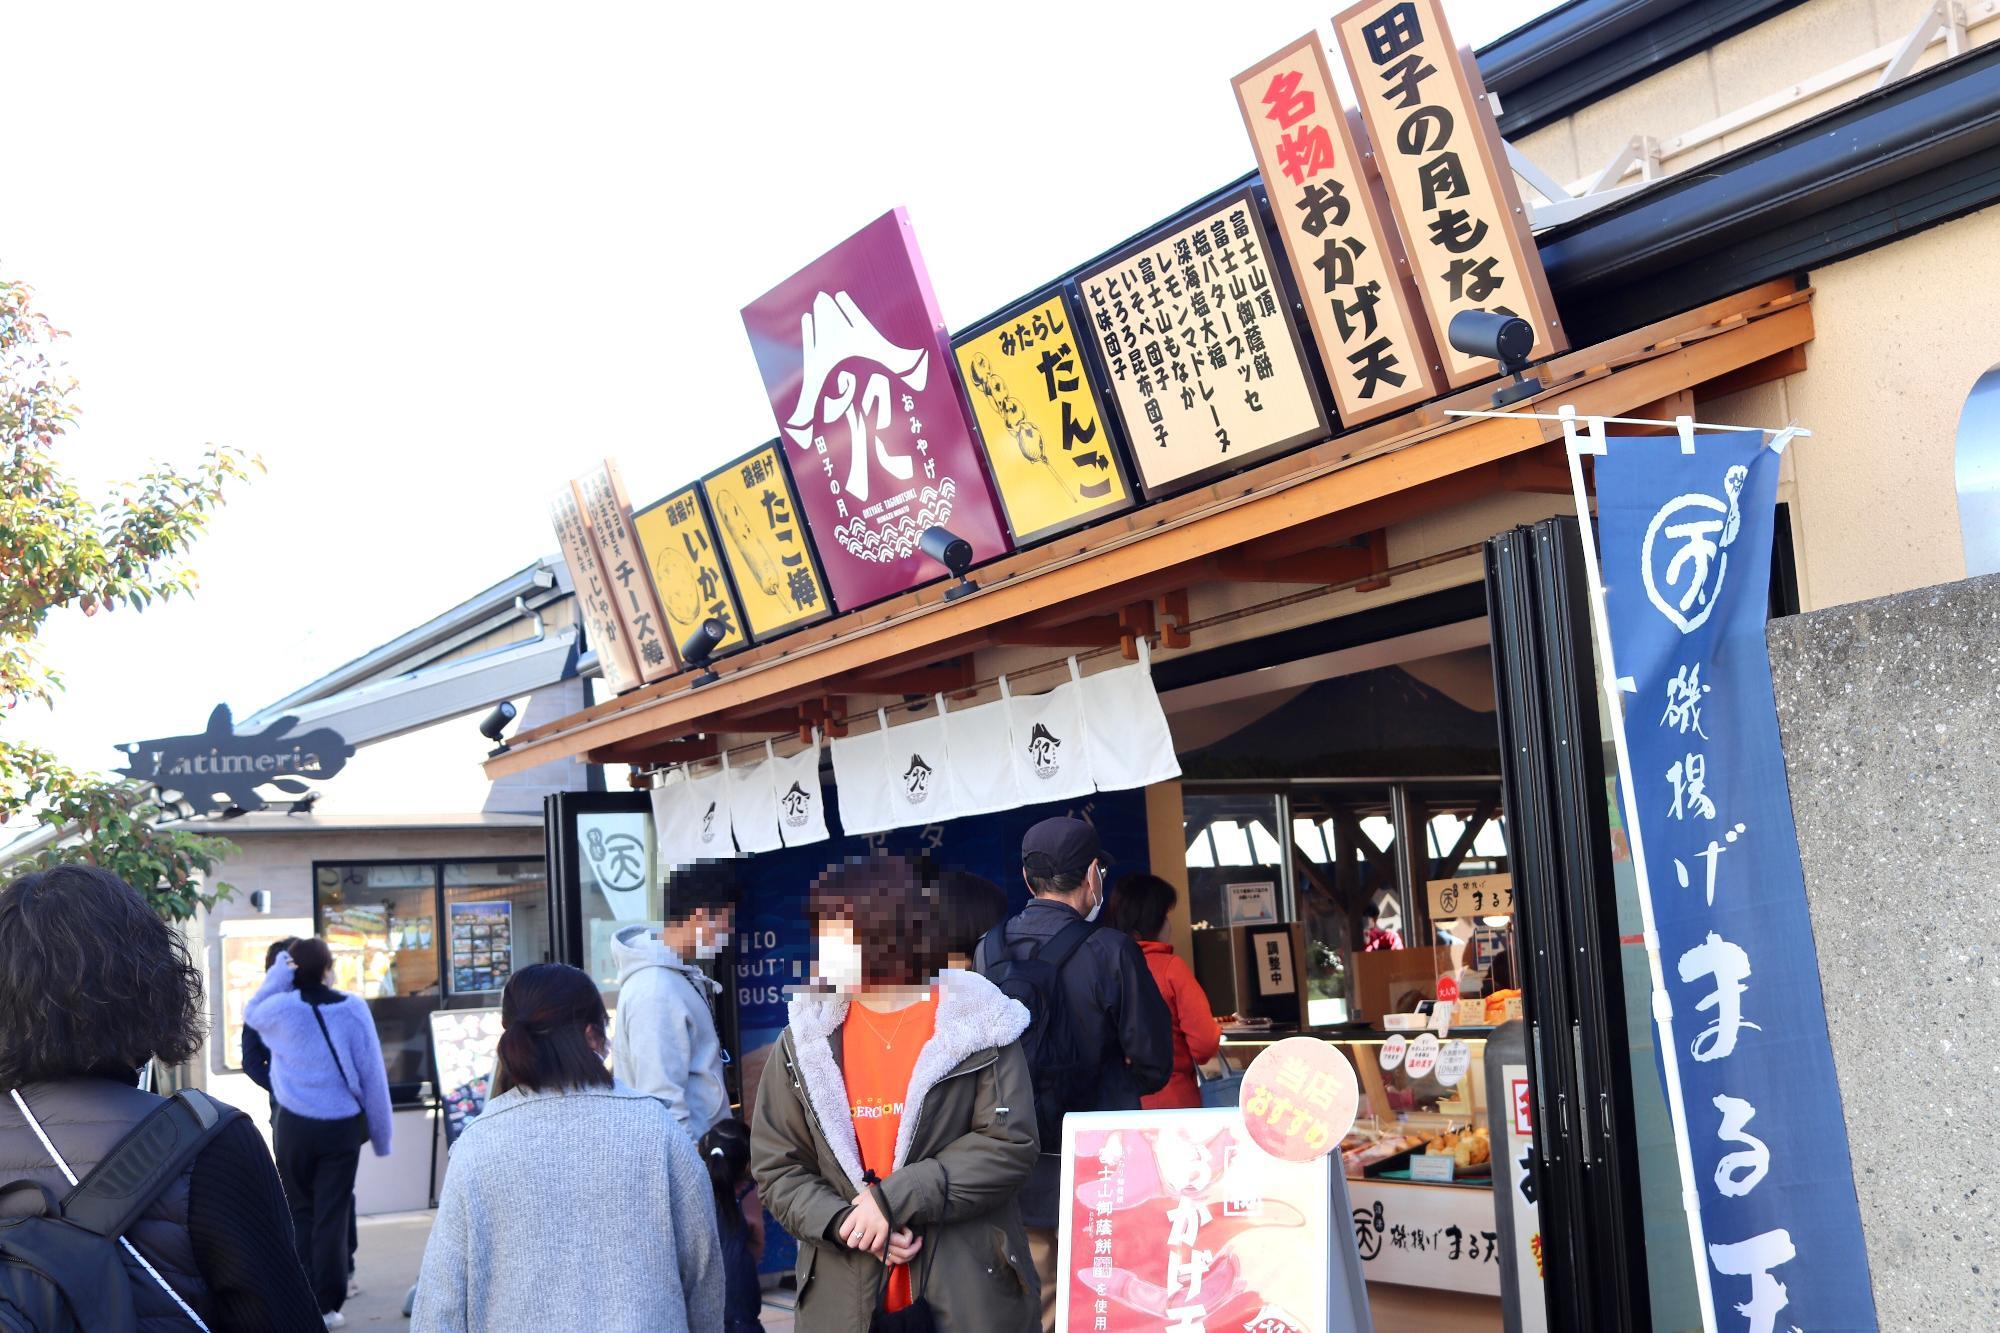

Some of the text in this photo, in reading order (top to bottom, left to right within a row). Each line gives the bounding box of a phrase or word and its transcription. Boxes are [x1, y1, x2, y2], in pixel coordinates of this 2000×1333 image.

[1261, 69, 1407, 399] 名物おかげ天
[1362, 2, 1520, 358] 田子の月もな
[1174, 238, 1227, 370] 深海塩大福
[1229, 210, 1277, 318] 富士山頂
[998, 310, 1064, 356] みたらし
[1089, 285, 1127, 380] 七味団子
[1106, 277, 1168, 448] とろろ昆布団子
[1121, 270, 1168, 391] いそべ団子
[1138, 257, 1195, 410] 富士山もなか
[1156, 252, 1231, 453] レモンマドレーヌ
[1192, 229, 1263, 412] 塩バターブッセ
[740, 455, 775, 489] 磯揚げ
[815, 435, 849, 518] 田子の月
[901, 393, 937, 480] おみやげ
[1036, 347, 1112, 498] だんご
[664, 496, 696, 527] 磯揚げ
[760, 489, 819, 611] たこ棒
[614, 560, 666, 668] チーズ棒
[682, 529, 737, 635] いか天
[1266, 941, 1282, 986] 調整中
[1094, 1146, 1113, 1254] 士山御蔭餅
